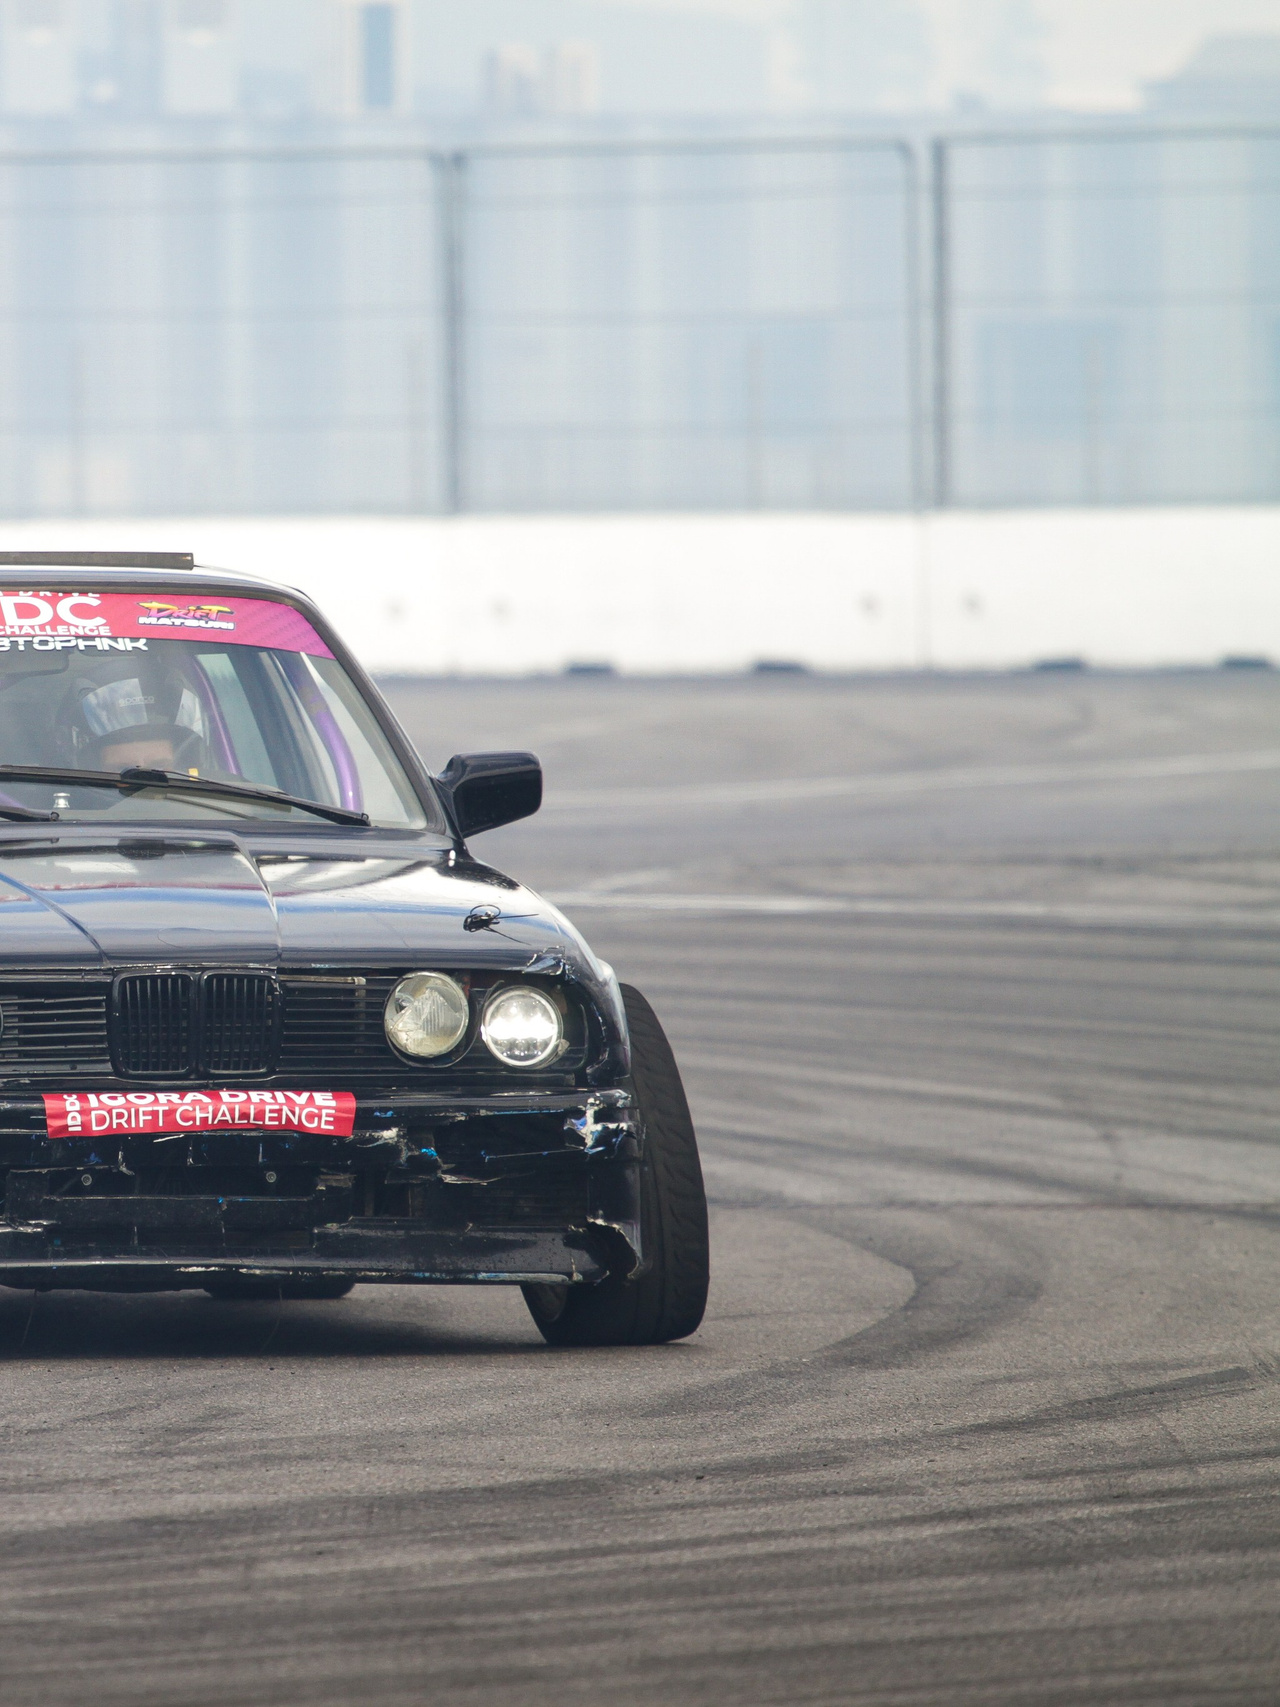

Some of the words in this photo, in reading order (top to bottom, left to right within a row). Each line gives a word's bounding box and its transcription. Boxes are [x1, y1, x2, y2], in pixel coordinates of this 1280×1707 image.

[87, 1092, 212, 1107] IGORA
[219, 1091, 337, 1107] DRIVE
[90, 1106, 169, 1131] DRIFT
[175, 1104, 336, 1130] CHALLENGE
